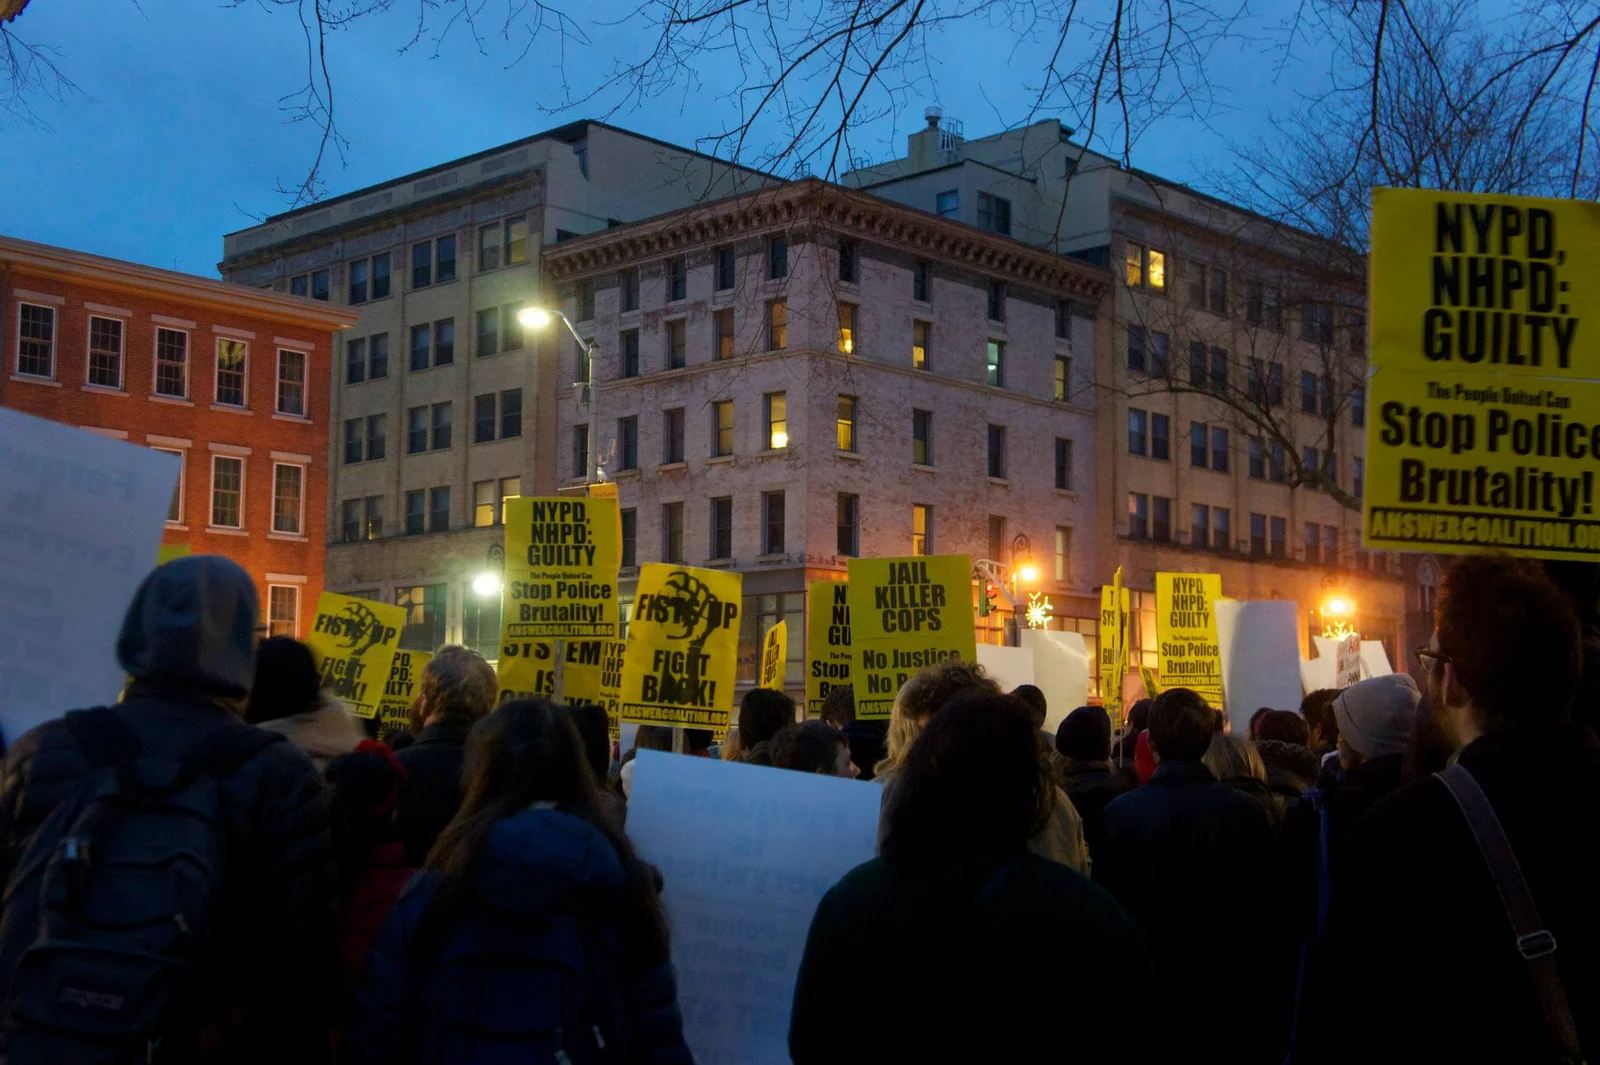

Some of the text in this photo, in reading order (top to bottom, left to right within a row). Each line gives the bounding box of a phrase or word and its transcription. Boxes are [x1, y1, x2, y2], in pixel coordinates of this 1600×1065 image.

[1435, 202, 1565, 265] NYPD,
[1432, 255, 1570, 314] NHPD:
[1423, 308, 1579, 368] GUILTY
[1427, 381, 1450, 399] The
[1455, 383, 1498, 405] People
[1381, 400, 1475, 454] Stop
[1400, 458, 1594, 517] Brutality!
[532, 501, 590, 524] NYPD,
[531, 523, 592, 544] NHPD:
[1373, 511, 1600, 548] ANSWERCOALITION.OR
[527, 544, 596, 566] GUILTY
[888, 562, 930, 585] JAIL
[510, 581, 611, 601] Stop Police
[875, 584, 946, 609] KILLER
[1173, 577, 1206, 595] NYPD,
[520, 603, 604, 623] Brutality!
[1172, 594, 1207, 612] NHPD:
[882, 608, 942, 632] COPS
[1170, 611, 1209, 628] GUILTY
[392, 652, 413, 668] PD,
[504, 641, 602, 665] SYSEM
[863, 649, 887, 670] No
[1162, 642, 1219, 658] Stop Police
[390, 667, 412, 681] PD:
[811, 660, 850, 680] Stop
[1167, 660, 1215, 676] Brutality!
[385, 680, 414, 697] ILTY
[868, 674, 892, 694] No
